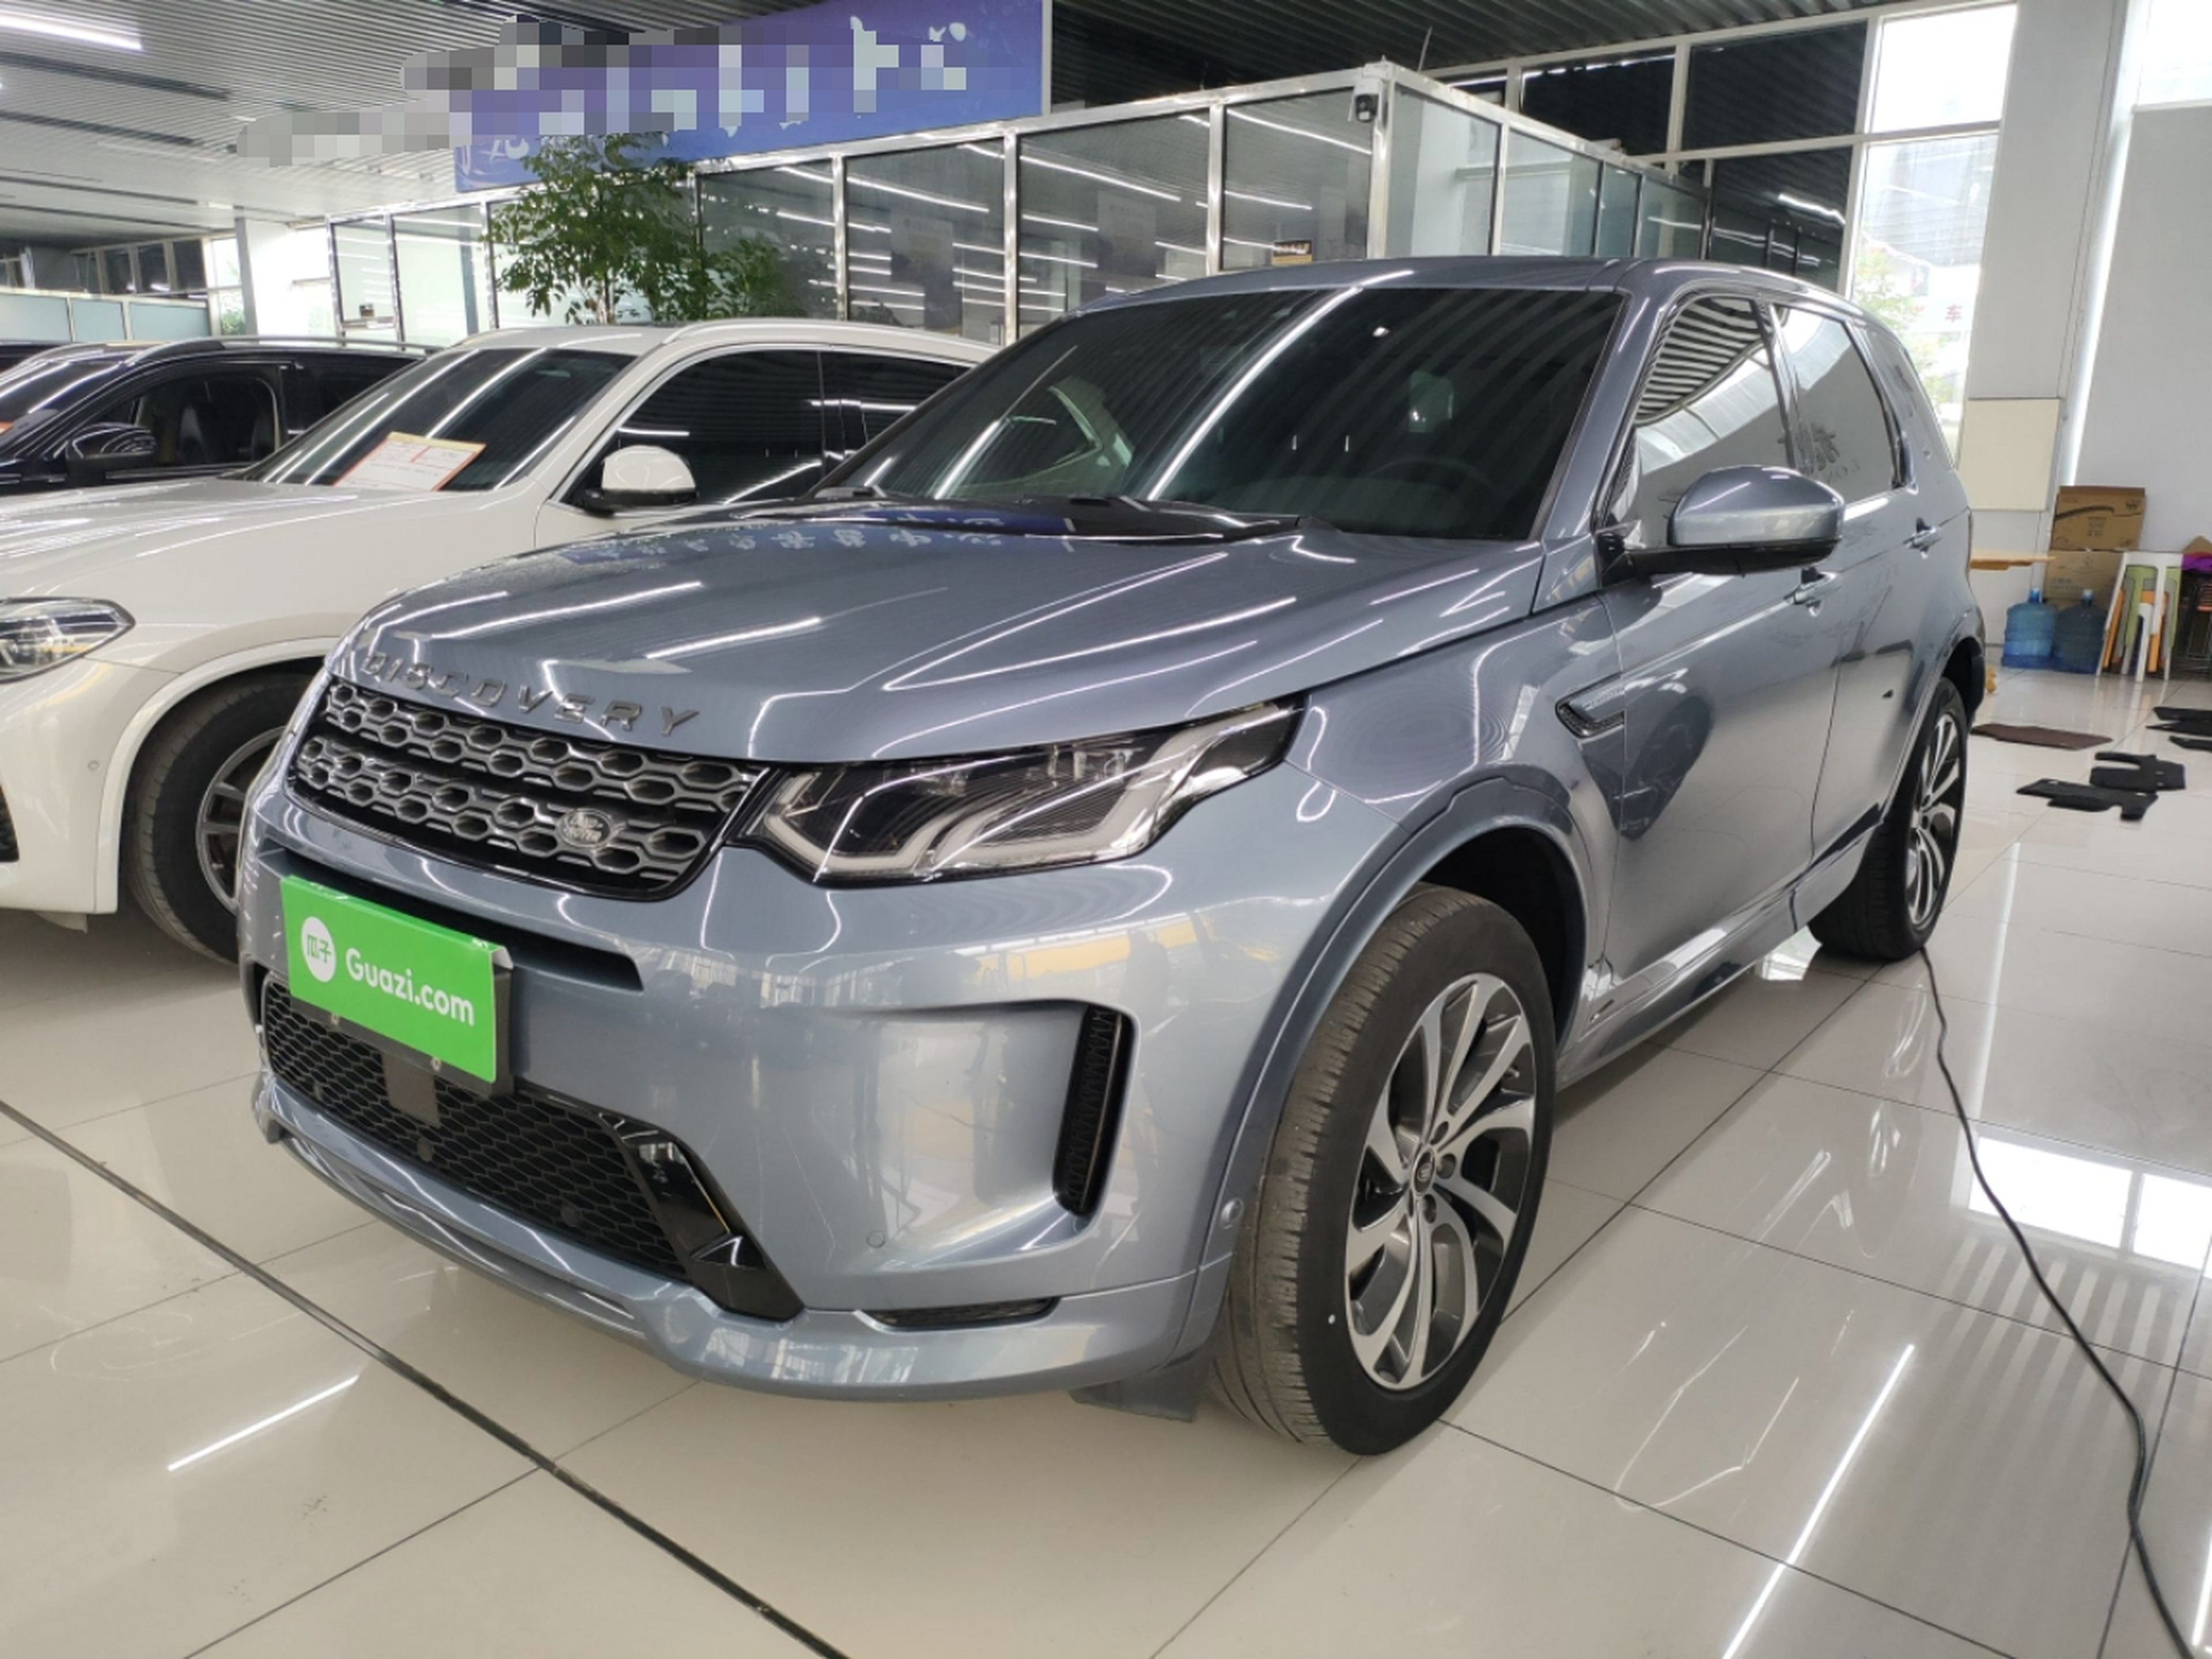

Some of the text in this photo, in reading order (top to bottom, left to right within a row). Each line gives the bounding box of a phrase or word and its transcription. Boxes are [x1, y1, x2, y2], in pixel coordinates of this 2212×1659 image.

[1945, 305, 1963, 323] 车
[361, 652, 699, 736] DISCOVERY
[306, 934, 332, 964] 瓜子
[346, 948, 474, 1027] Guazi.com
